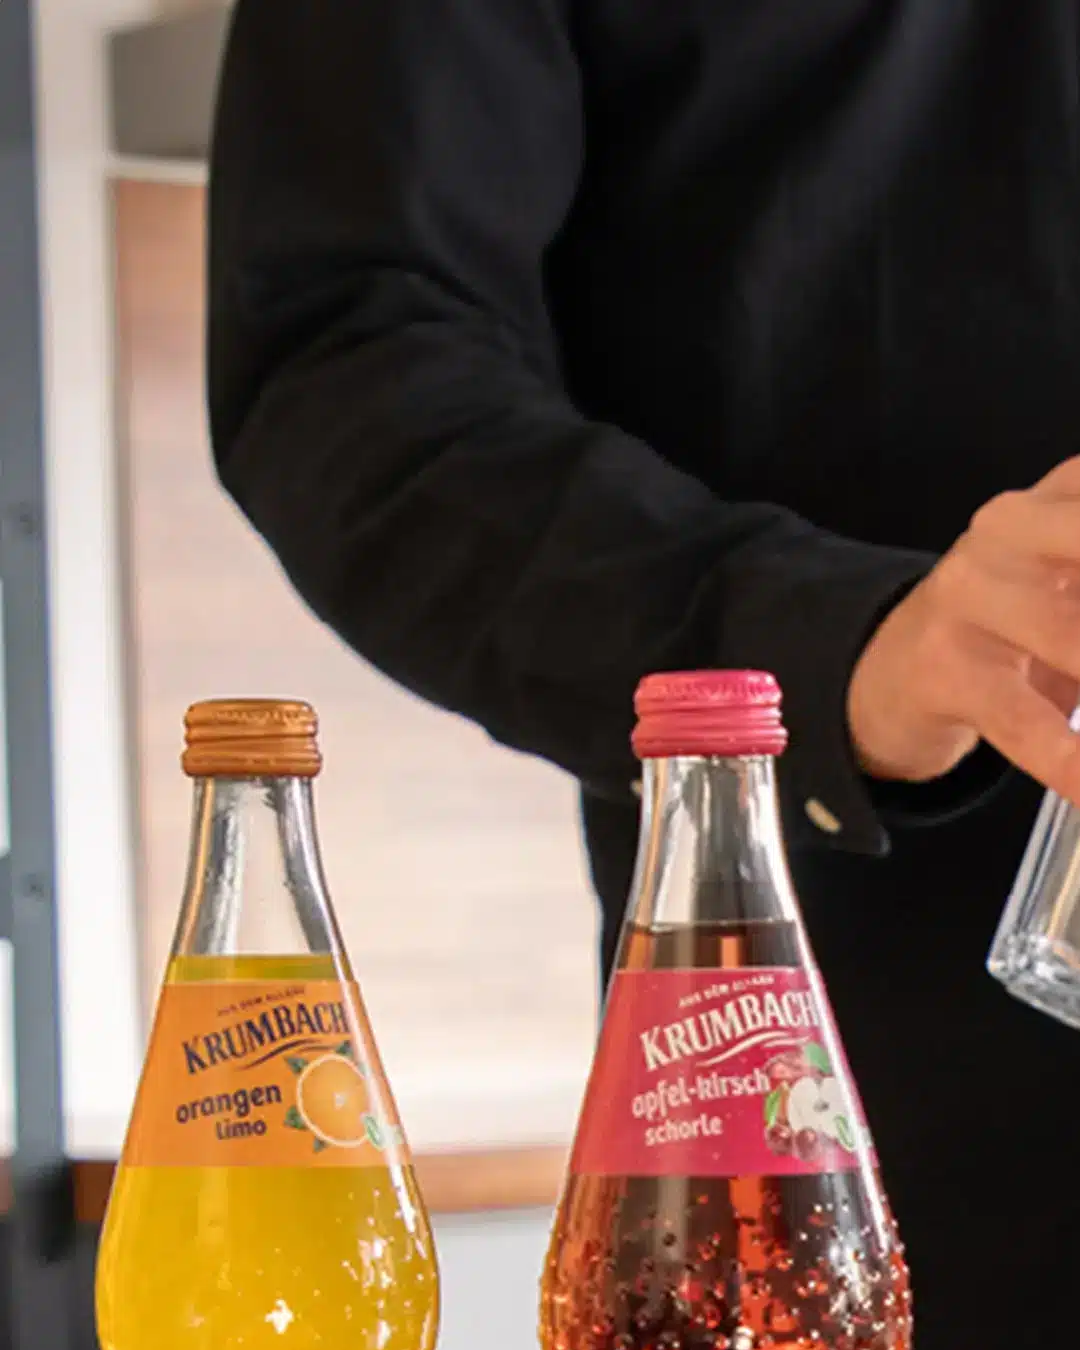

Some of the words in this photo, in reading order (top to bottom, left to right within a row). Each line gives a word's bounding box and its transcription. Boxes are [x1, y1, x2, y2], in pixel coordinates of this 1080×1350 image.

[181, 1001, 349, 1075] KRUMBACH
[639, 989, 821, 1074] KRUMBACH
[175, 1083, 283, 1125] orangen
[631, 1067, 771, 1123] apfel-kirsch
[215, 1115, 268, 1140] limo
[644, 1113, 723, 1147] schorle
